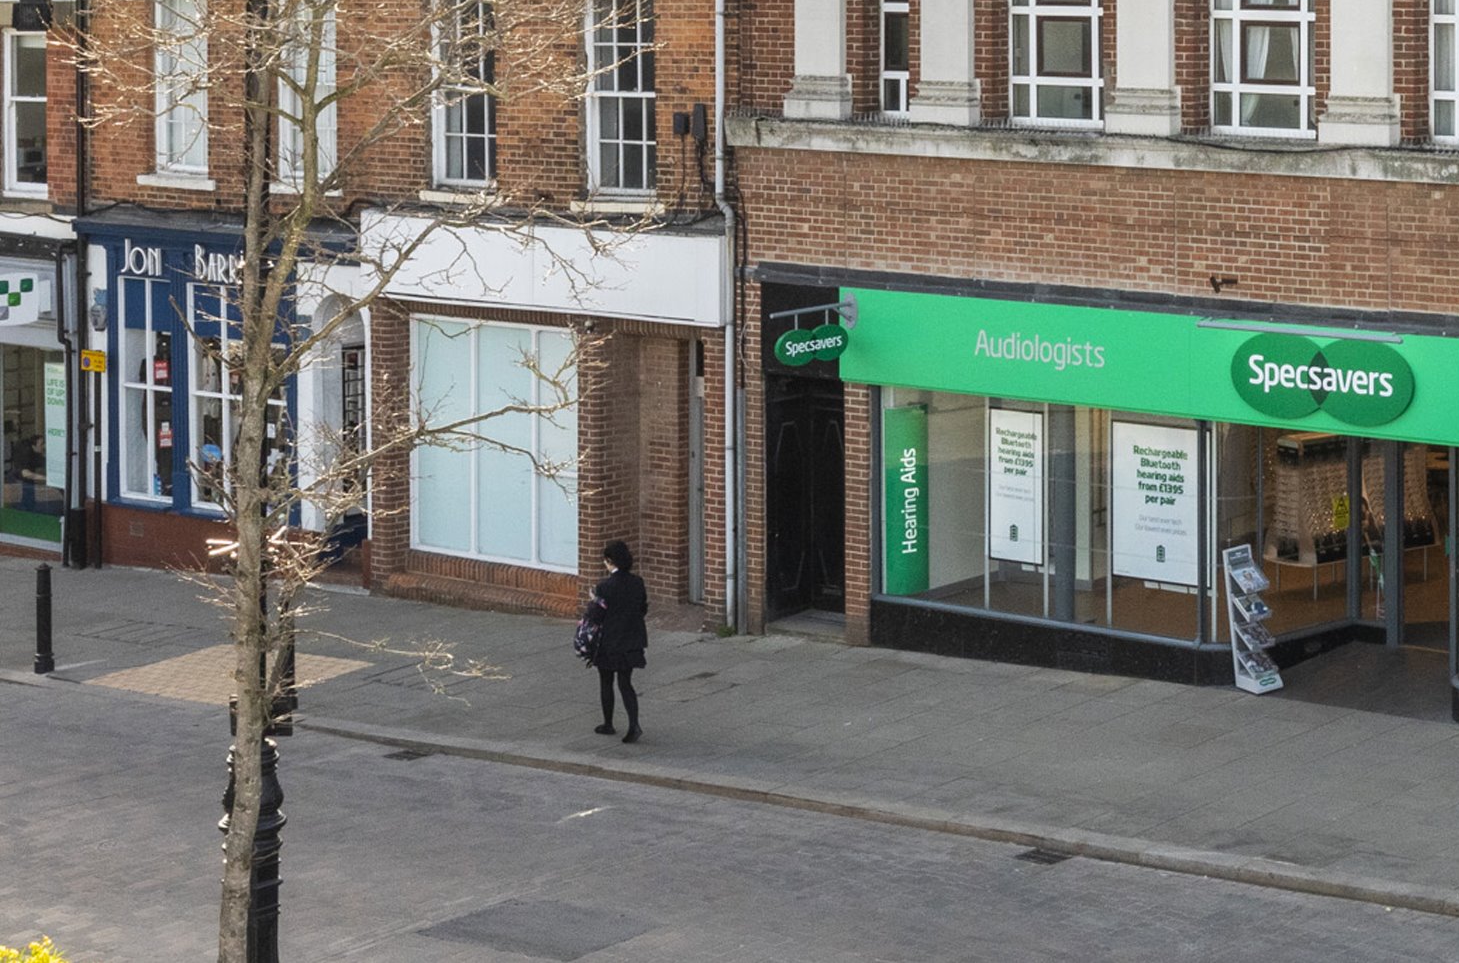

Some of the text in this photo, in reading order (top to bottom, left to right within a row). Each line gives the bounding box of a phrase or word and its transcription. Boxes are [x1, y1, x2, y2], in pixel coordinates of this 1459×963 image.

[785, 334, 843, 358] Specsavers
[974, 329, 1106, 371] Audiologists
[1248, 354, 1394, 398] Specsavers
[998, 455, 1014, 465] from
[1132, 444, 1189, 461] Rechargeable
[1003, 466, 1028, 477] per pair
[1140, 457, 1182, 471] Bluetooth
[1136, 469, 1185, 484] hearing aids
[1138, 480, 1184, 495] from £1395
[900, 447, 919, 554] Hearing Aids
[1144, 494, 1176, 506] per pair
